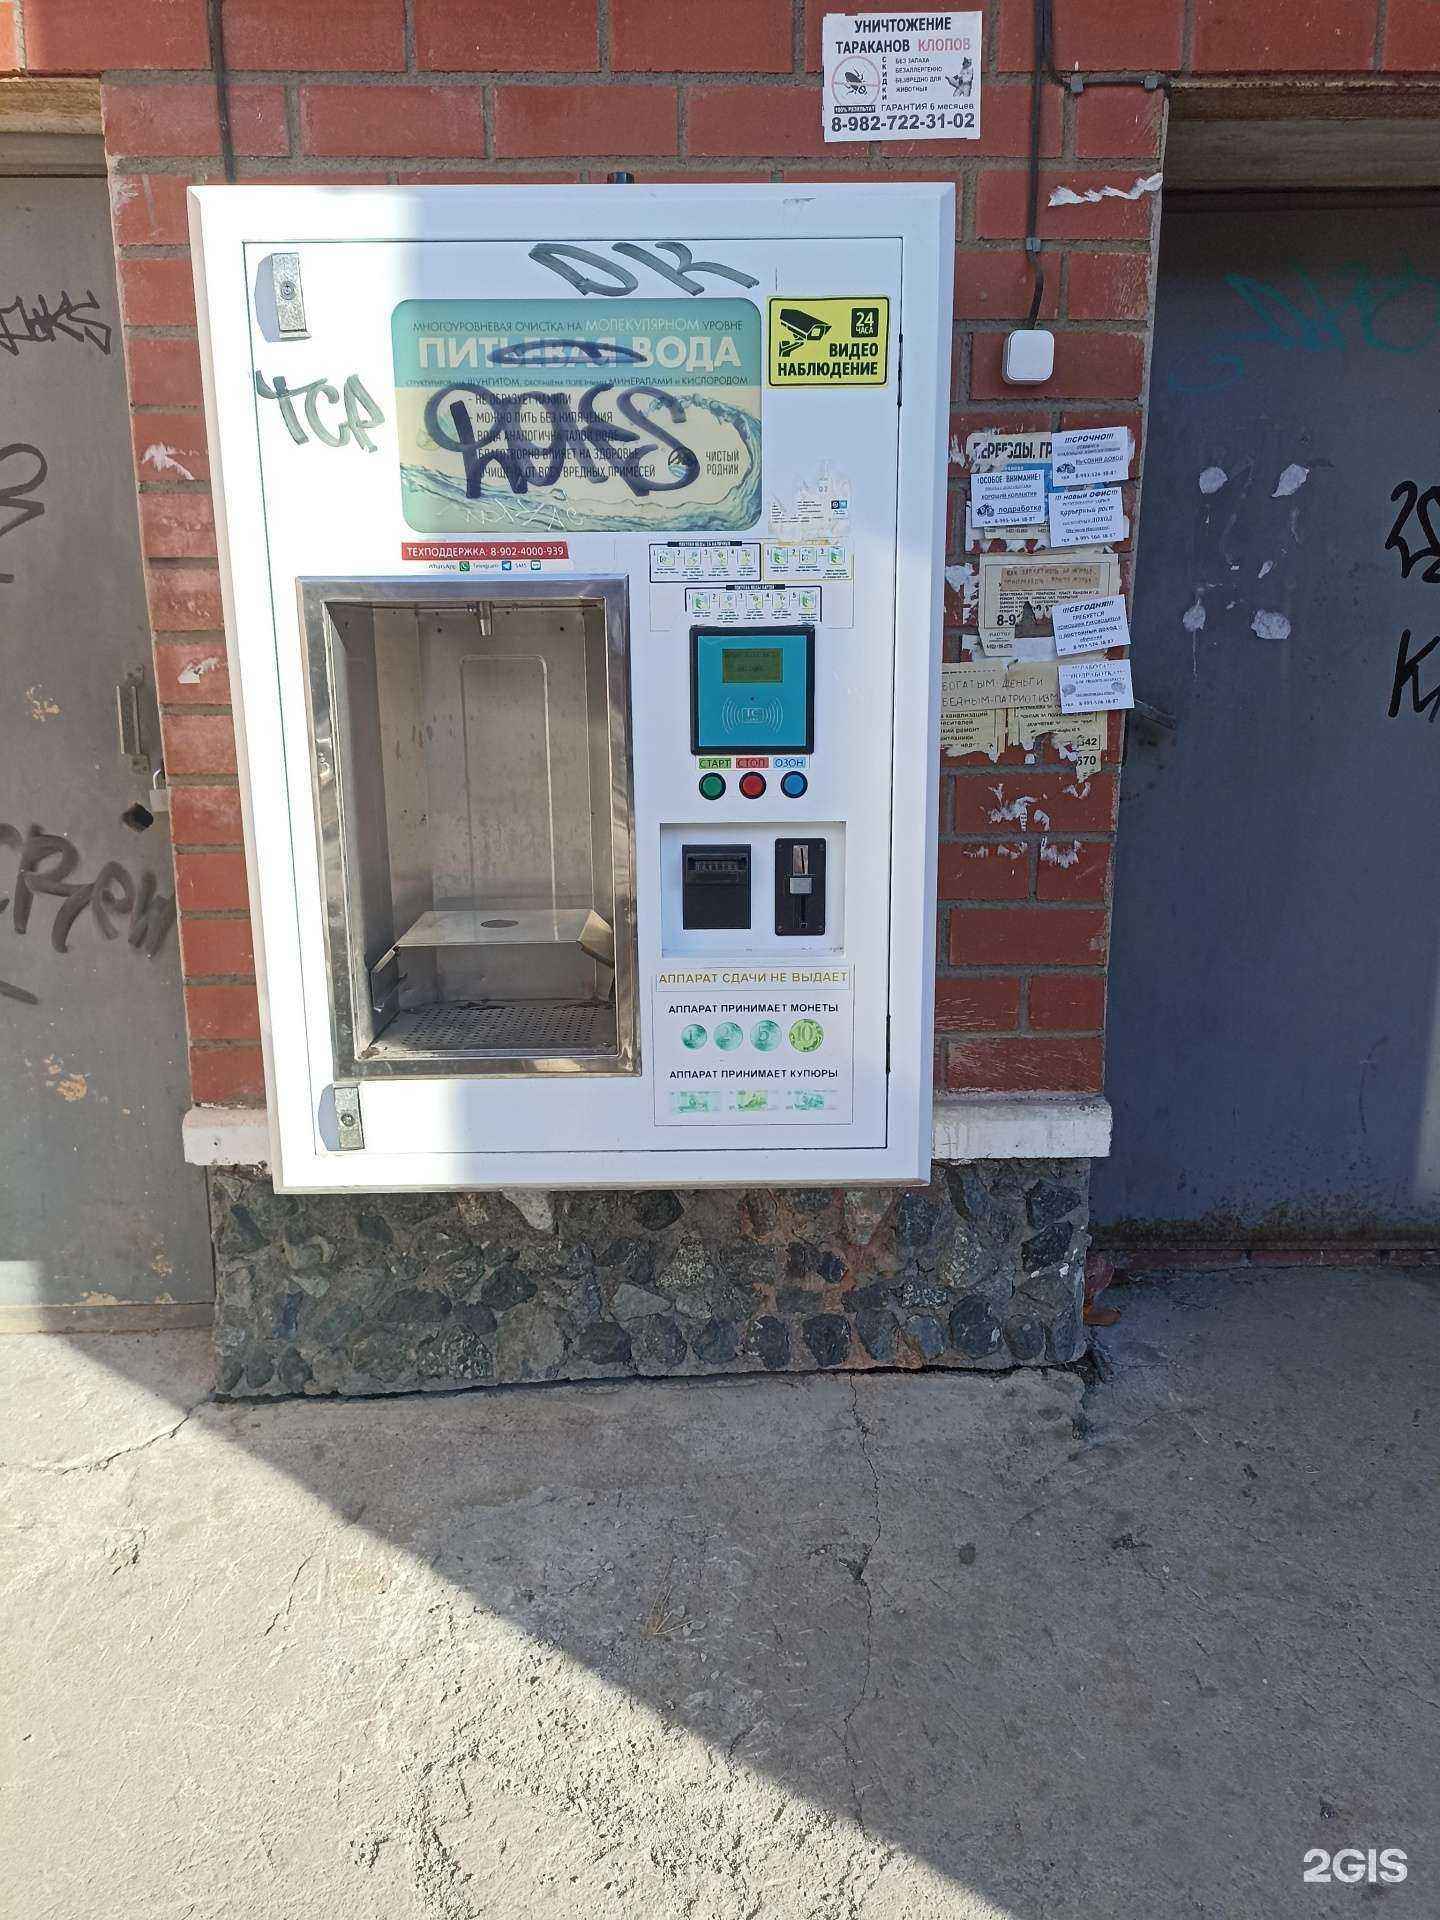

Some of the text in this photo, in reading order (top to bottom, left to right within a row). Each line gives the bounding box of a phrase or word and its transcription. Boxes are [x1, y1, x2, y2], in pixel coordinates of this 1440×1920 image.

[854, 17, 951, 33] УНИЧТОЖЕНИЕ
[836, 38, 970, 54] ТАРАКАНОВ КЛОПОВ
[882, 103, 928, 112] ГАРАНТИЯ
[832, 113, 975, 132] 8-982-722-31-02
[413, 318, 744, 332] МНОГОУРОВНЕВАЯ ОЧИСТКА НА МОЛЕКУЛЯРНОМ УРОВНЕ
[856, 312, 874, 326] 24
[856, 326, 874, 334] ЧАСА
[632, 336, 742, 372] ВОДА
[829, 342, 879, 360] ВИДЕО
[778, 361, 878, 379] НАБЛЮДЕНИЕ
[608, 376, 673, 386] МИНЕРАЛАМИ
[682, 376, 749, 386] КИСЛОРОДОМ
[514, 412, 538, 424] ПИТЬ
[580, 448, 592, 460] НА
[706, 450, 740, 464] ЧИСТЫЙ
[564, 466, 605, 480] ВРЕДНЫХ
[608, 464, 656, 478] ПРИМЕСЕЙ
[706, 464, 740, 476] РОДНИК
[490, 546, 564, 557] 8-902-4000-939
[700, 759, 731, 768] СТАРТ
[775, 758, 804, 768] ОЗОН
[659, 972, 848, 984] АППАРАТ СДАЧИ НЕ ВЫДАЕТ
[668, 1003, 838, 1014] АППАРАТ ПРИНИМАЕТ МОНЕТЫ
[669, 1069, 838, 1079] АППАРАТ ПРИНИМАЕТ КУПЮРЫ
